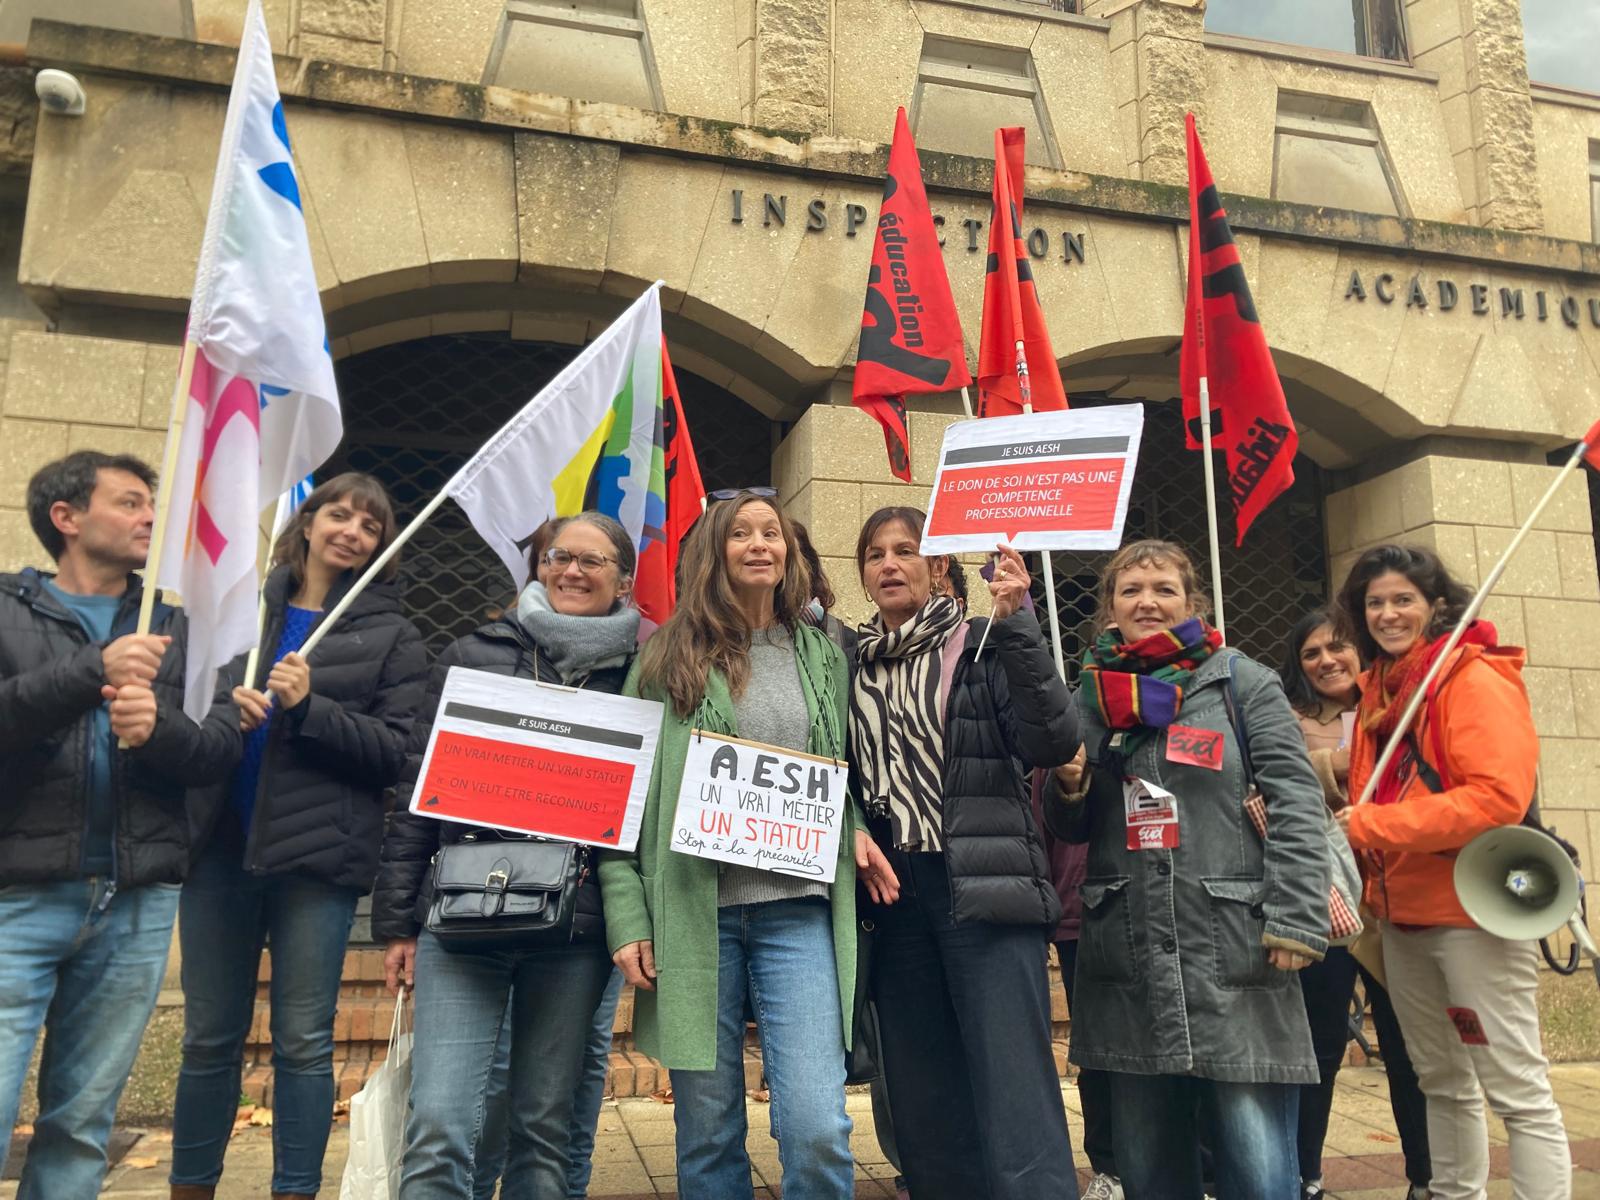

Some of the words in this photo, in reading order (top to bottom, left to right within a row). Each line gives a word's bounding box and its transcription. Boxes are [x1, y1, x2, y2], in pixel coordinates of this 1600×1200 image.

[879, 212, 924, 348] éducation
[1001, 446, 1012, 457] JE
[1013, 445, 1034, 456] SUIS
[1035, 443, 1060, 454] AESH
[943, 482, 956, 493] LE
[957, 479, 983, 491] DON
[985, 477, 999, 489] DE
[1002, 475, 1023, 488] SOI
[1024, 473, 1058, 486] N'EST
[1061, 472, 1085, 484] PAS
[1087, 470, 1117, 483] UNE
[980, 488, 1063, 505] COMPETENCE
[965, 504, 1073, 521] PROFESSIONNELLE
[517, 718, 528, 727] JE
[529, 719, 548, 731] SUIS
[549, 722, 571, 735] AESH
[443, 743, 462, 755] UN
[464, 746, 490, 761] VRAI
[492, 753, 535, 769] METIER
[537, 761, 554, 772] UN
[557, 764, 583, 777] VRAI
[585, 768, 626, 785] STATUT
[450, 777, 469, 790] ON
[472, 781, 502, 796] VEUT
[504, 787, 532, 801] ETRE
[535, 792, 599, 814] RECONNUS
[700, 783, 722, 805] UN
[700, 810, 733, 837] UN
[745, 818, 827, 853] STATUT
[676, 828, 707, 854] Stop
[712, 837, 725, 851] à
[725, 839, 747, 855] la
[753, 847, 820, 870] précarité
